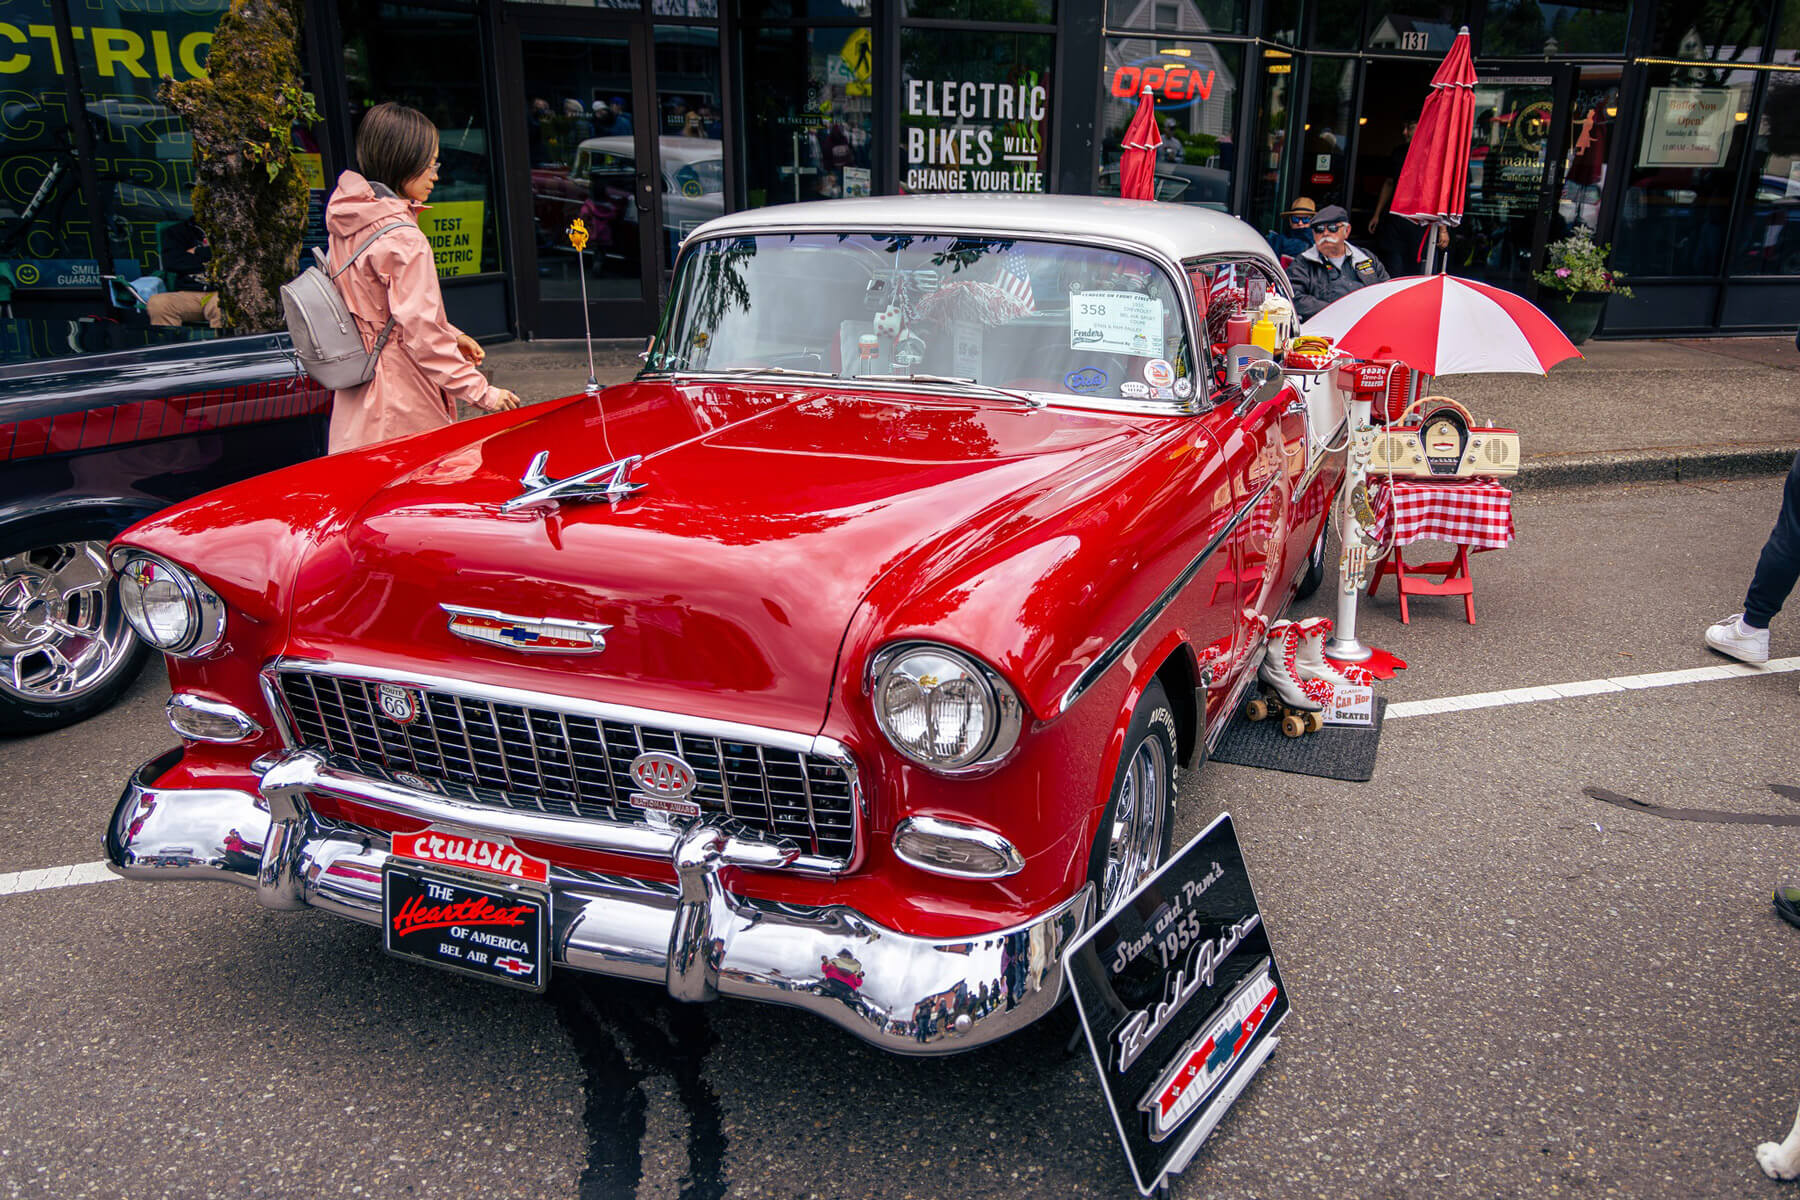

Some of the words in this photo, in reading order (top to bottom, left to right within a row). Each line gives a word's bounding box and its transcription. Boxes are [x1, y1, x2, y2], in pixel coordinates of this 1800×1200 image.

[1405, 33, 1427, 50] 131
[1111, 66, 1215, 100] OPEN
[909, 79, 1046, 121] ELECTRIC
[908, 127, 993, 166] BIKES
[1003, 136, 1038, 154] WILL
[908, 169, 967, 190] CHANGE
[971, 171, 1010, 191] YOUR
[1012, 172, 1043, 192] LIFE
[433, 217, 463, 232] TEST
[453, 233, 469, 247] AN
[434, 249, 473, 264] ECTRIC
[57, 274, 101, 285] GUARAN
[1080, 304, 1106, 316] 358
[385, 696, 405, 716] 66
[1335, 696, 1352, 709] CAR
[1354, 695, 1370, 705] HOP
[1335, 710, 1370, 720] SKATES
[1147, 706, 1178, 756] AVENGER
[636, 760, 690, 791] AAA
[414, 835, 524, 876] cruisin
[428, 883, 455, 902] THE
[393, 894, 536, 932] Heartbeat
[1113, 931, 1153, 974] Stan
[1155, 895, 1184, 935] and
[1182, 861, 1225, 906] Pam's
[450, 925, 470, 942] OF
[470, 932, 531, 954] AMERICA
[1159, 910, 1201, 969] 1955
[439, 943, 463, 958] BEL
[465, 950, 489, 964] AIR
